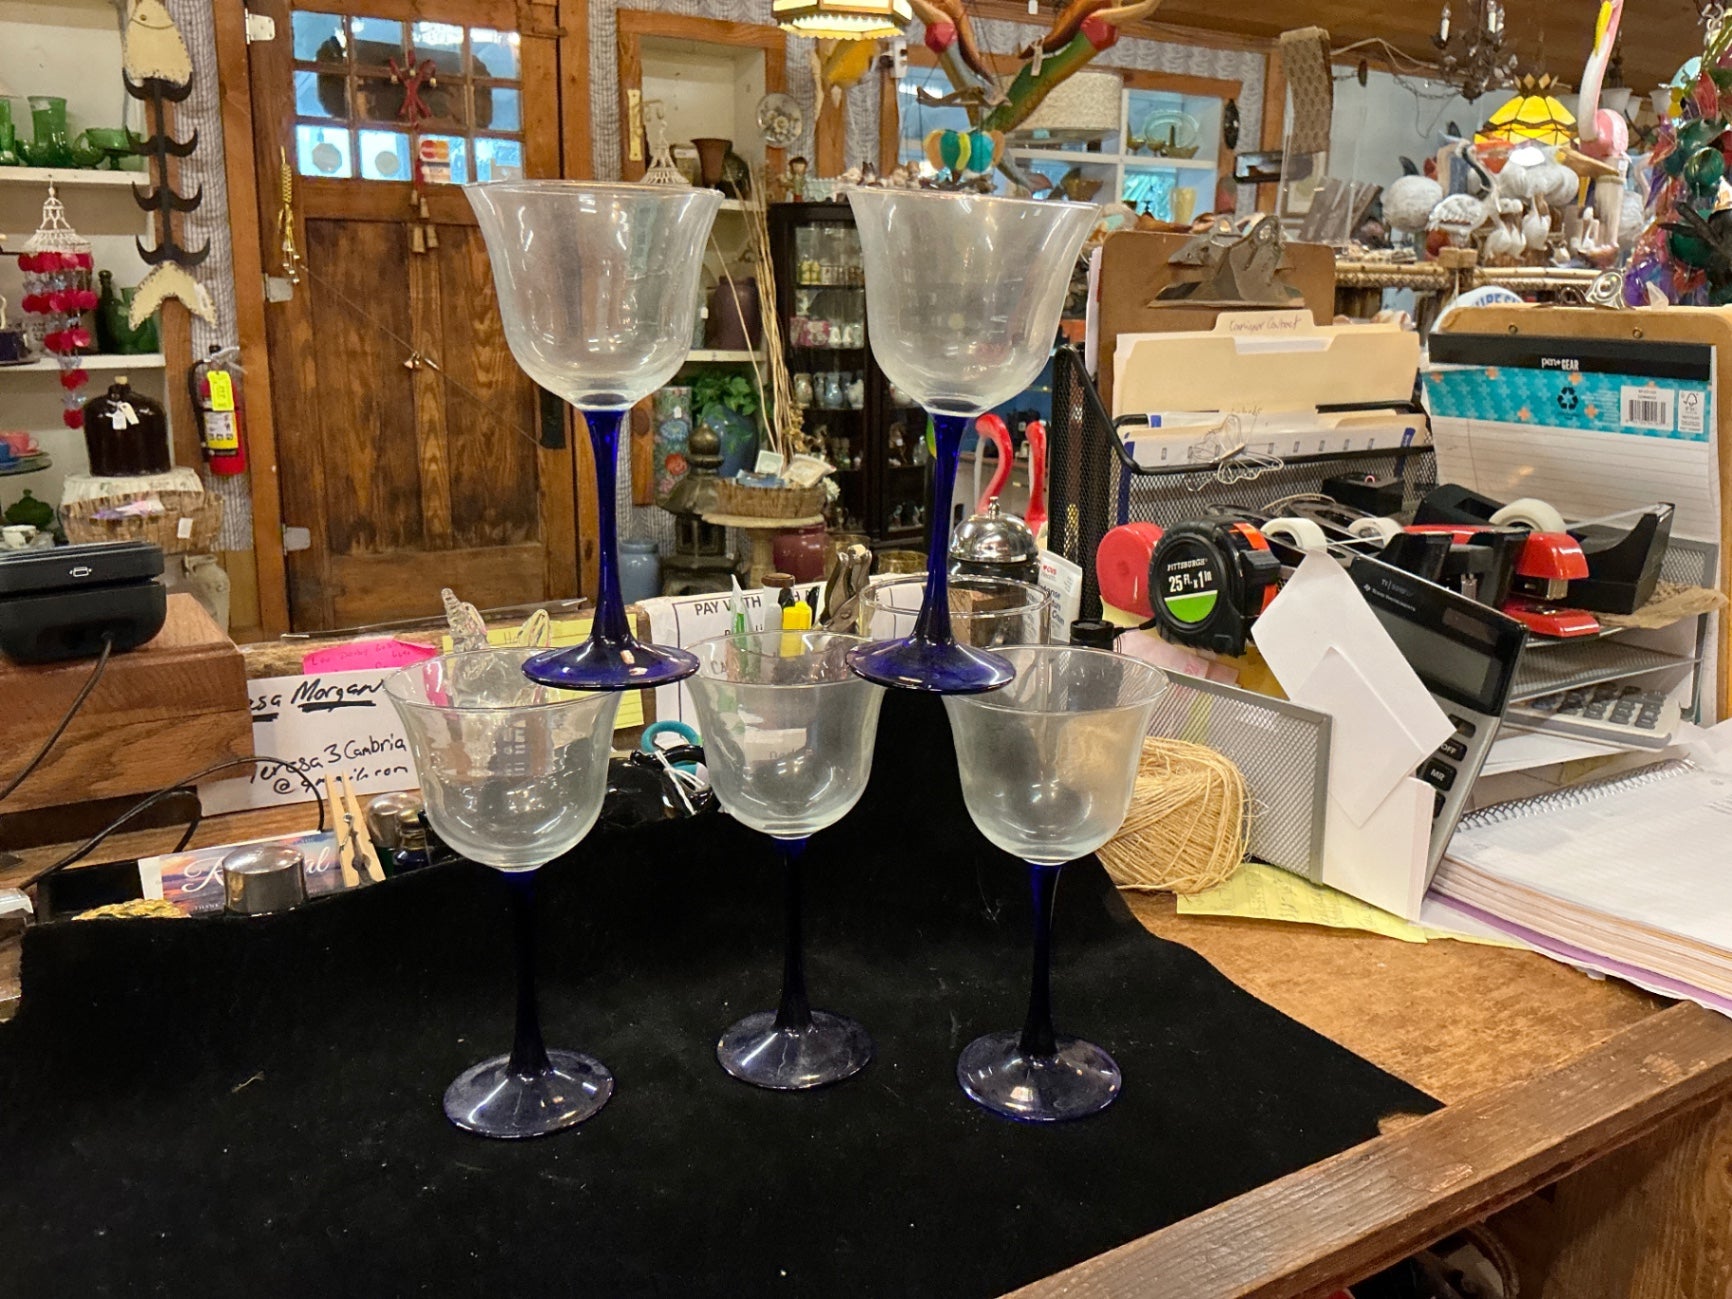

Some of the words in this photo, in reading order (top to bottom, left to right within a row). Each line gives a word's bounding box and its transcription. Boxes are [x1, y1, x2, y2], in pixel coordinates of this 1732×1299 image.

[1168, 574, 1183, 592] 25
[694, 600, 719, 616] PAY
[1430, 769, 1445, 781] MR
